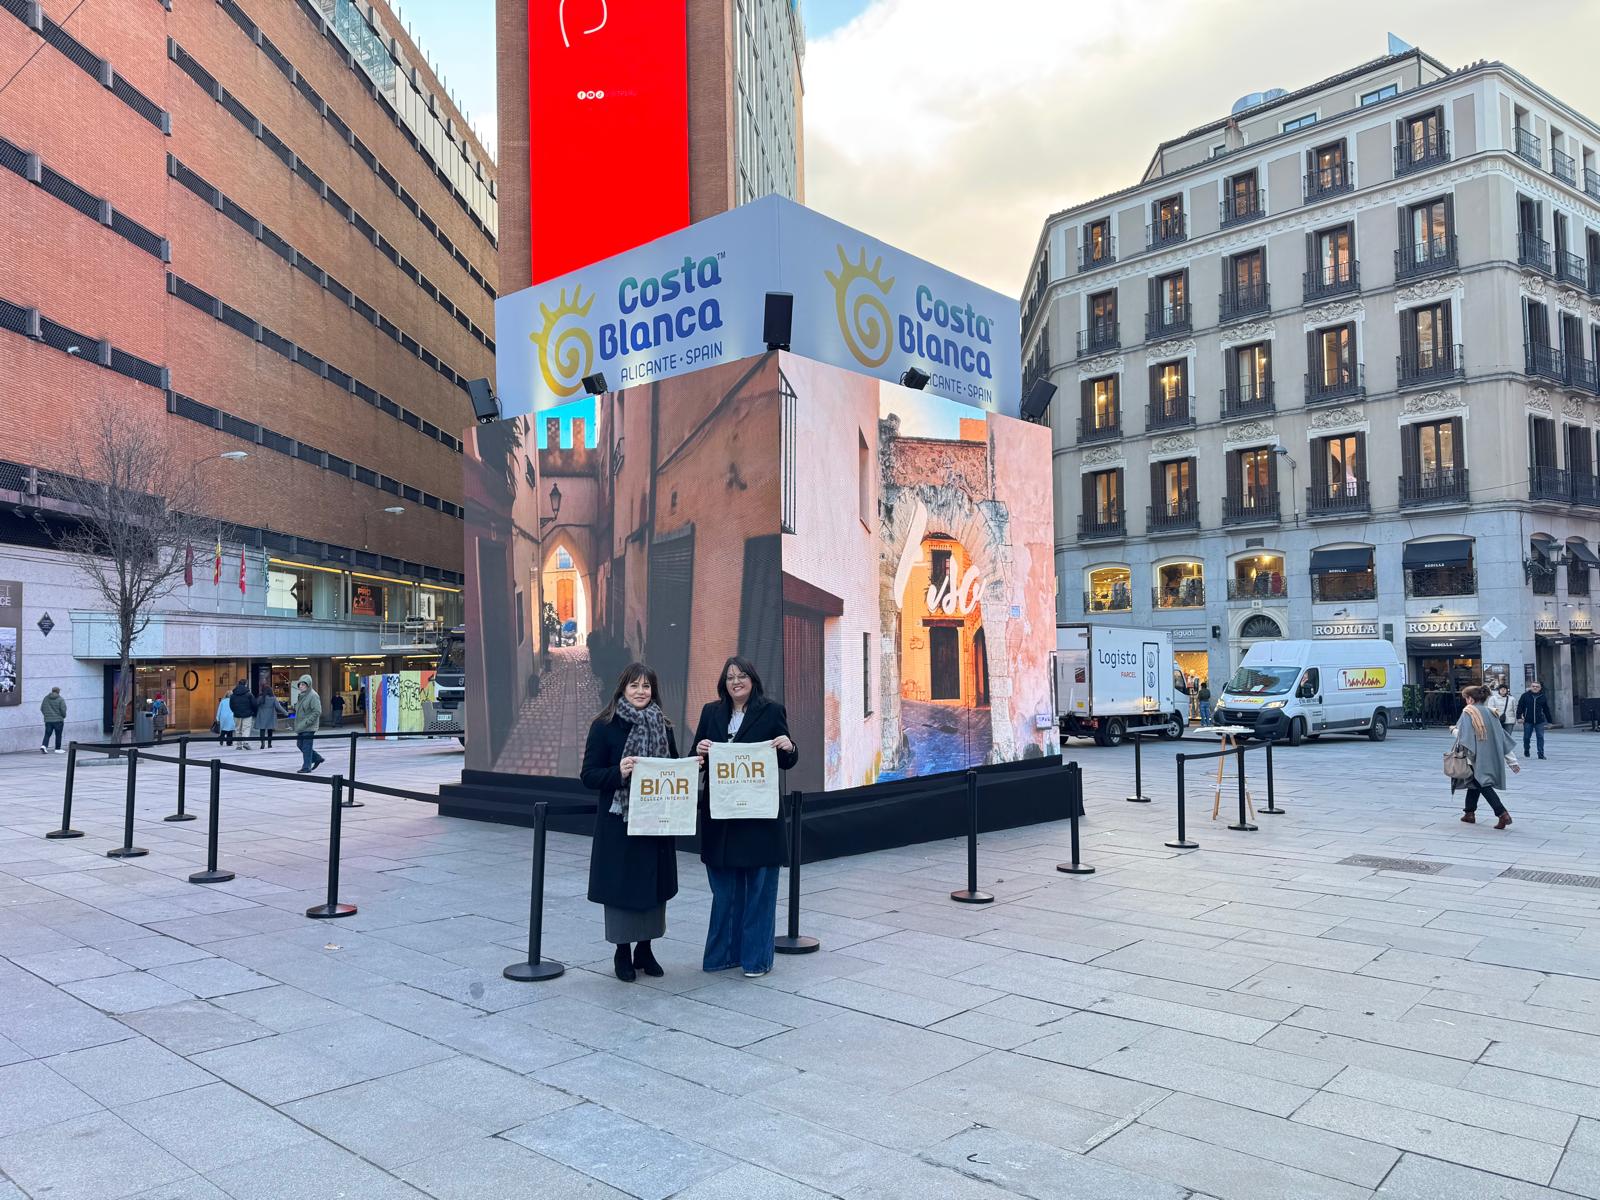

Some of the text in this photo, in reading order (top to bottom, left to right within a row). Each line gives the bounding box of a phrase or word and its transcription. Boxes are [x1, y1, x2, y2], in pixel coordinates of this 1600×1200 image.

[618, 256, 722, 315] Costa
[599, 298, 723, 361] Blanca
[915, 284, 992, 345] Costa
[621, 341, 723, 383] ALICANTE SPAIN
[898, 314, 993, 379] Blanca
[926, 372, 992, 404] ICANTE SPAIN
[1315, 624, 1376, 635] RODILLA
[1408, 621, 1477, 633] RODILLA
